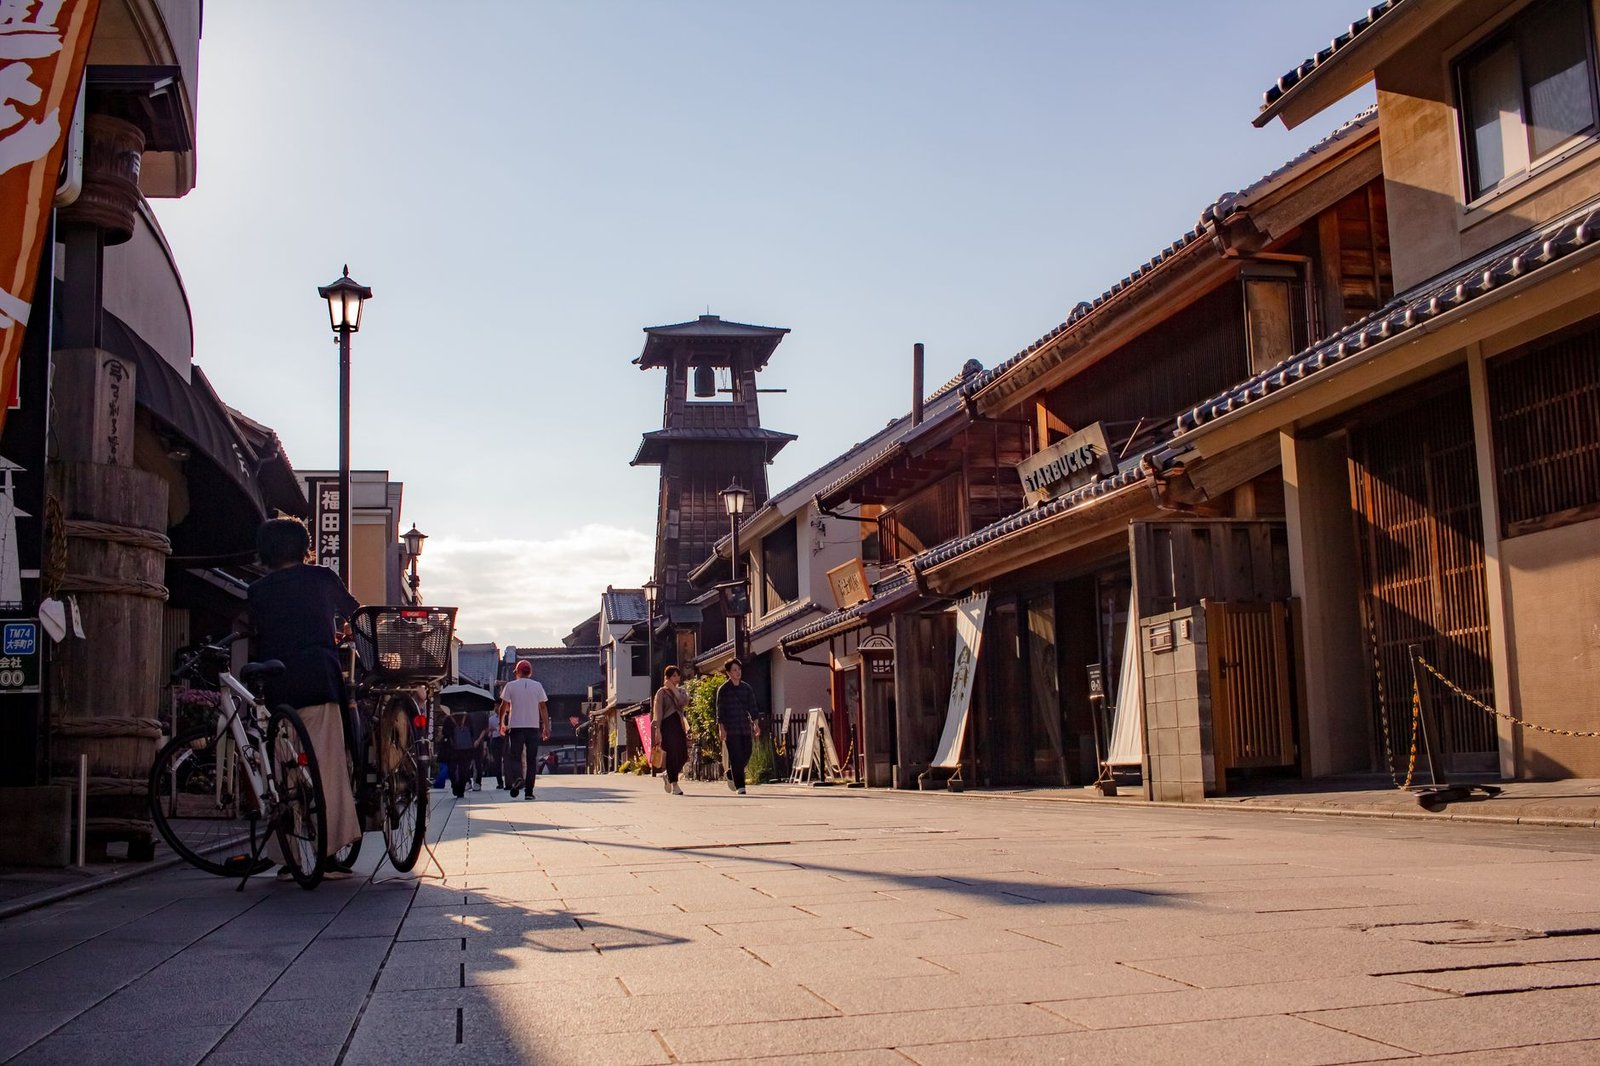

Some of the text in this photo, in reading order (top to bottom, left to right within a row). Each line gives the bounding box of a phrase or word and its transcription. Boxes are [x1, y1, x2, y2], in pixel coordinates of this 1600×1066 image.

[1024, 445, 1094, 492] STARBUCKS
[9, 628, 31, 639] TM74
[6, 639, 33, 650] 大手町P
[0, 657, 22, 668] 会社
